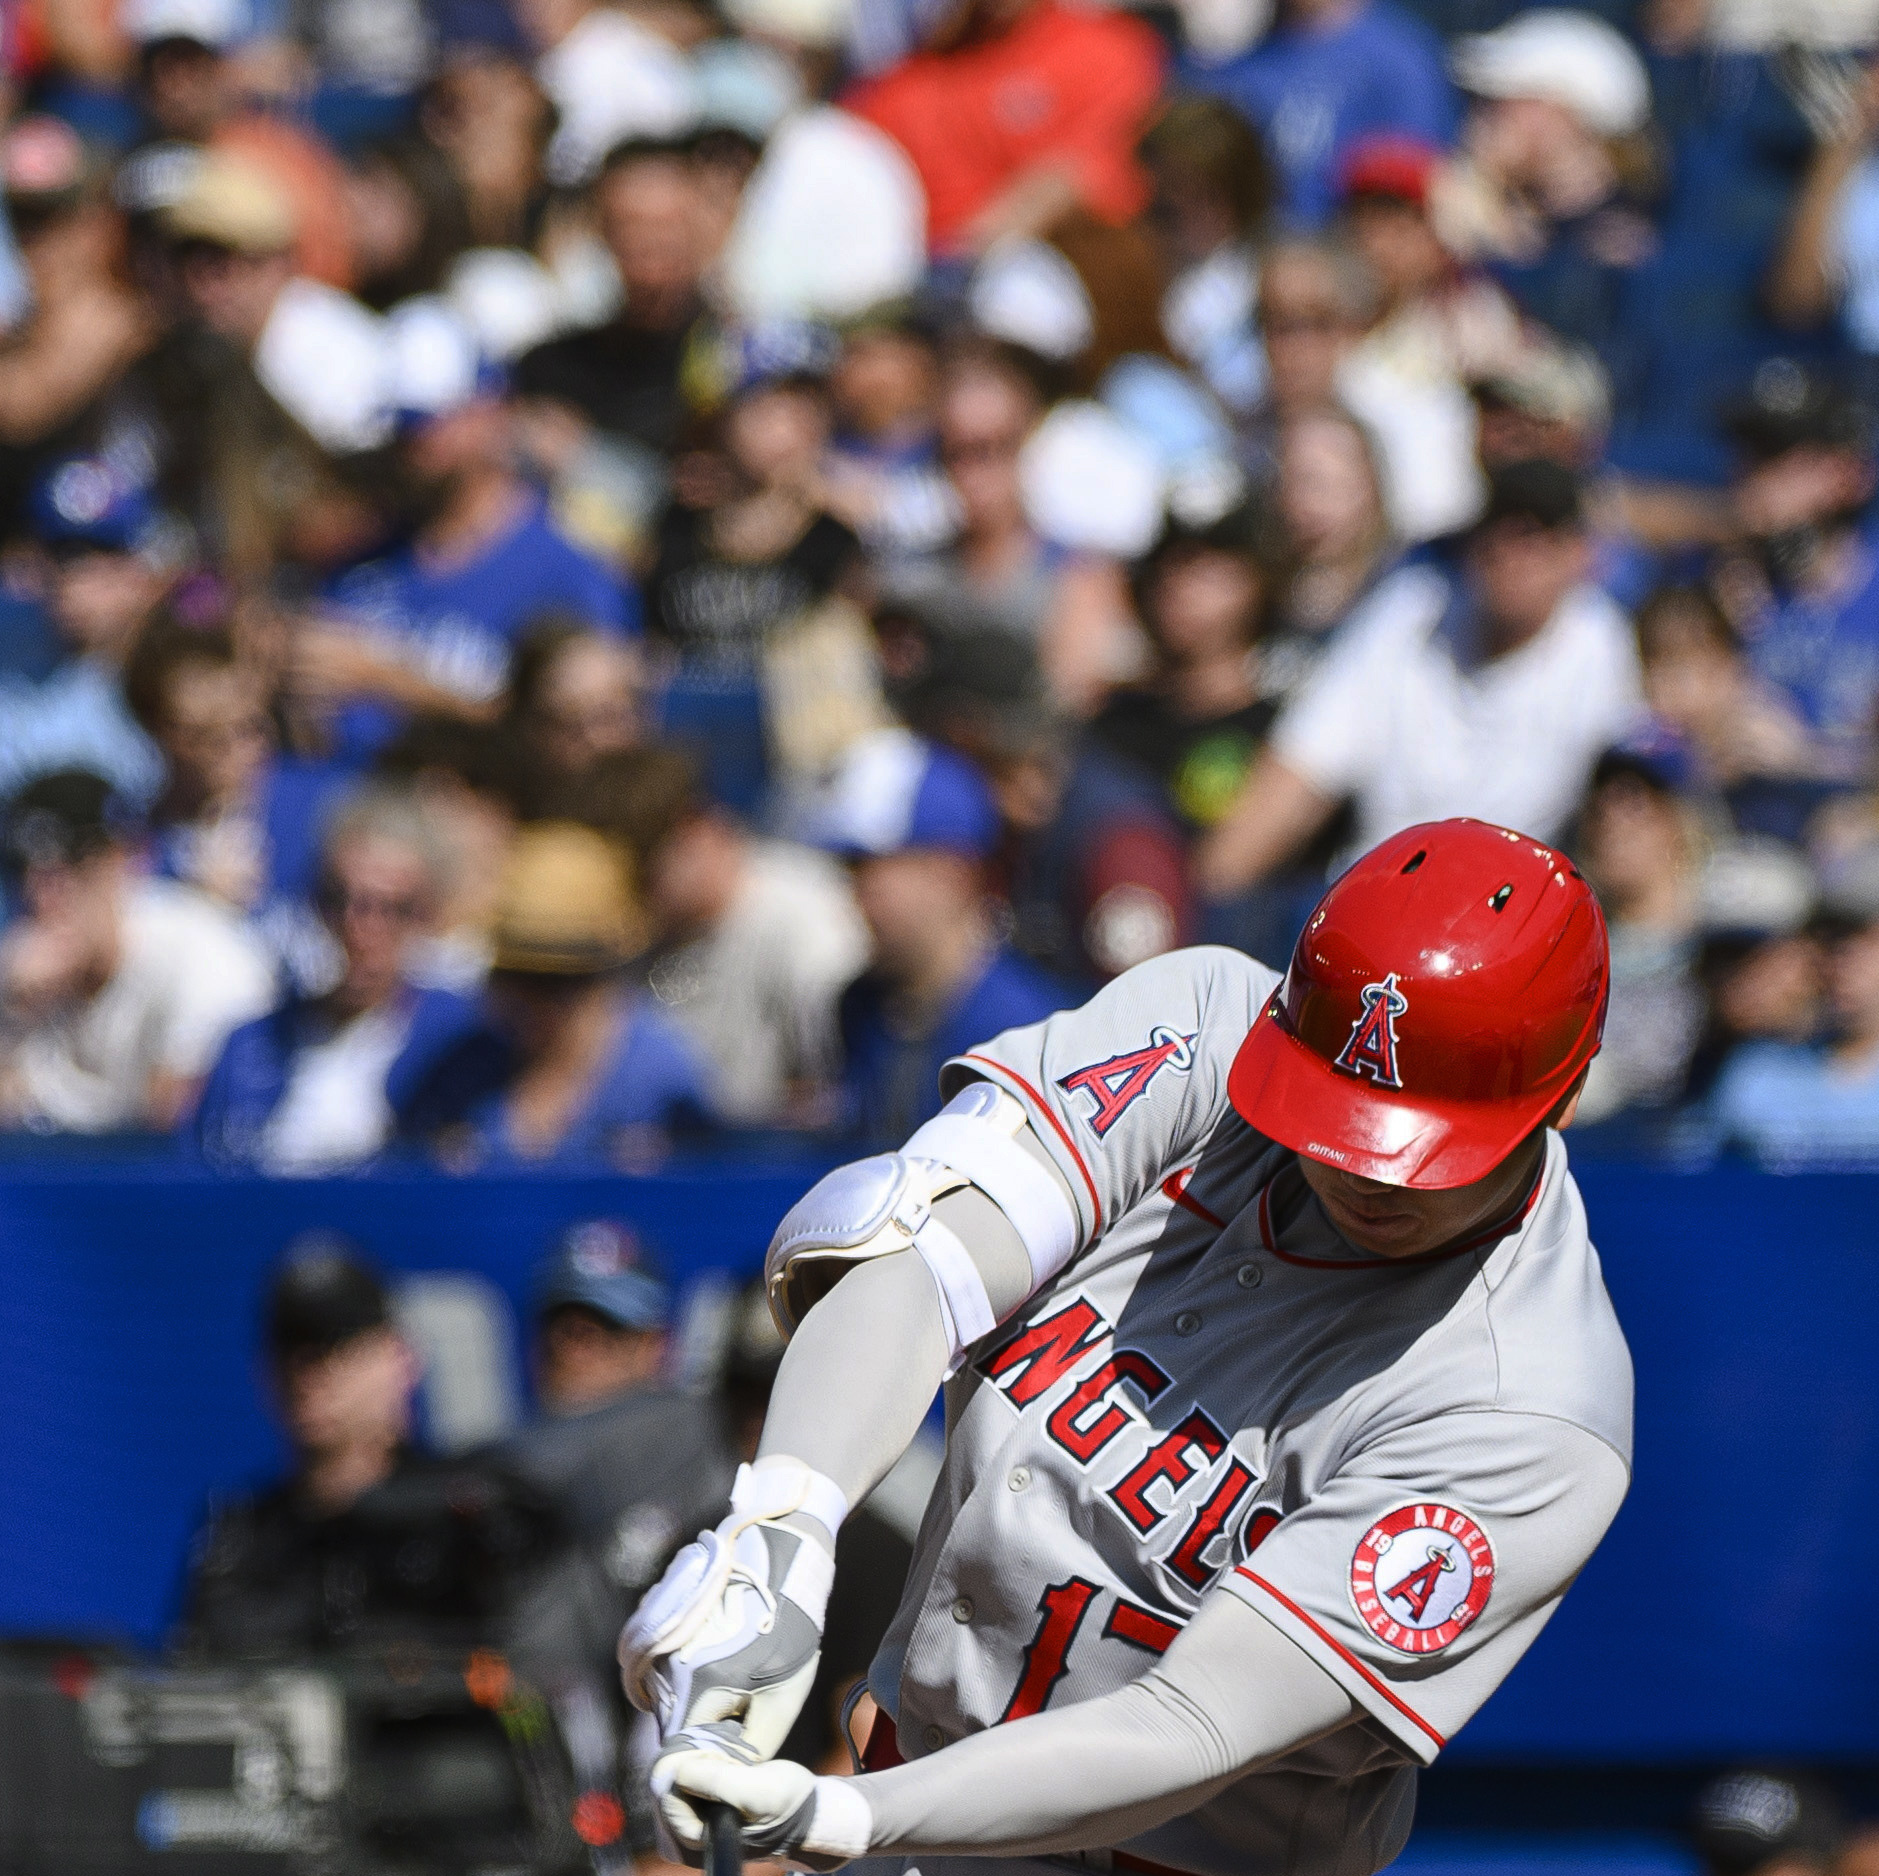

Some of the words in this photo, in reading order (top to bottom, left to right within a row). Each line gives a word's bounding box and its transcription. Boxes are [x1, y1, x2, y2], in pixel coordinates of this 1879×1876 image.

[1334, 973, 1408, 1091] A
[1056, 1025, 1199, 1140] A
[1307, 1142, 1346, 1164] OHTANI
[1364, 1528, 1393, 1555] 19
[1414, 1505, 1493, 1578] ANGELS
[1352, 1558, 1447, 1653] BASEBALL
[1382, 1542, 1457, 1624] A
